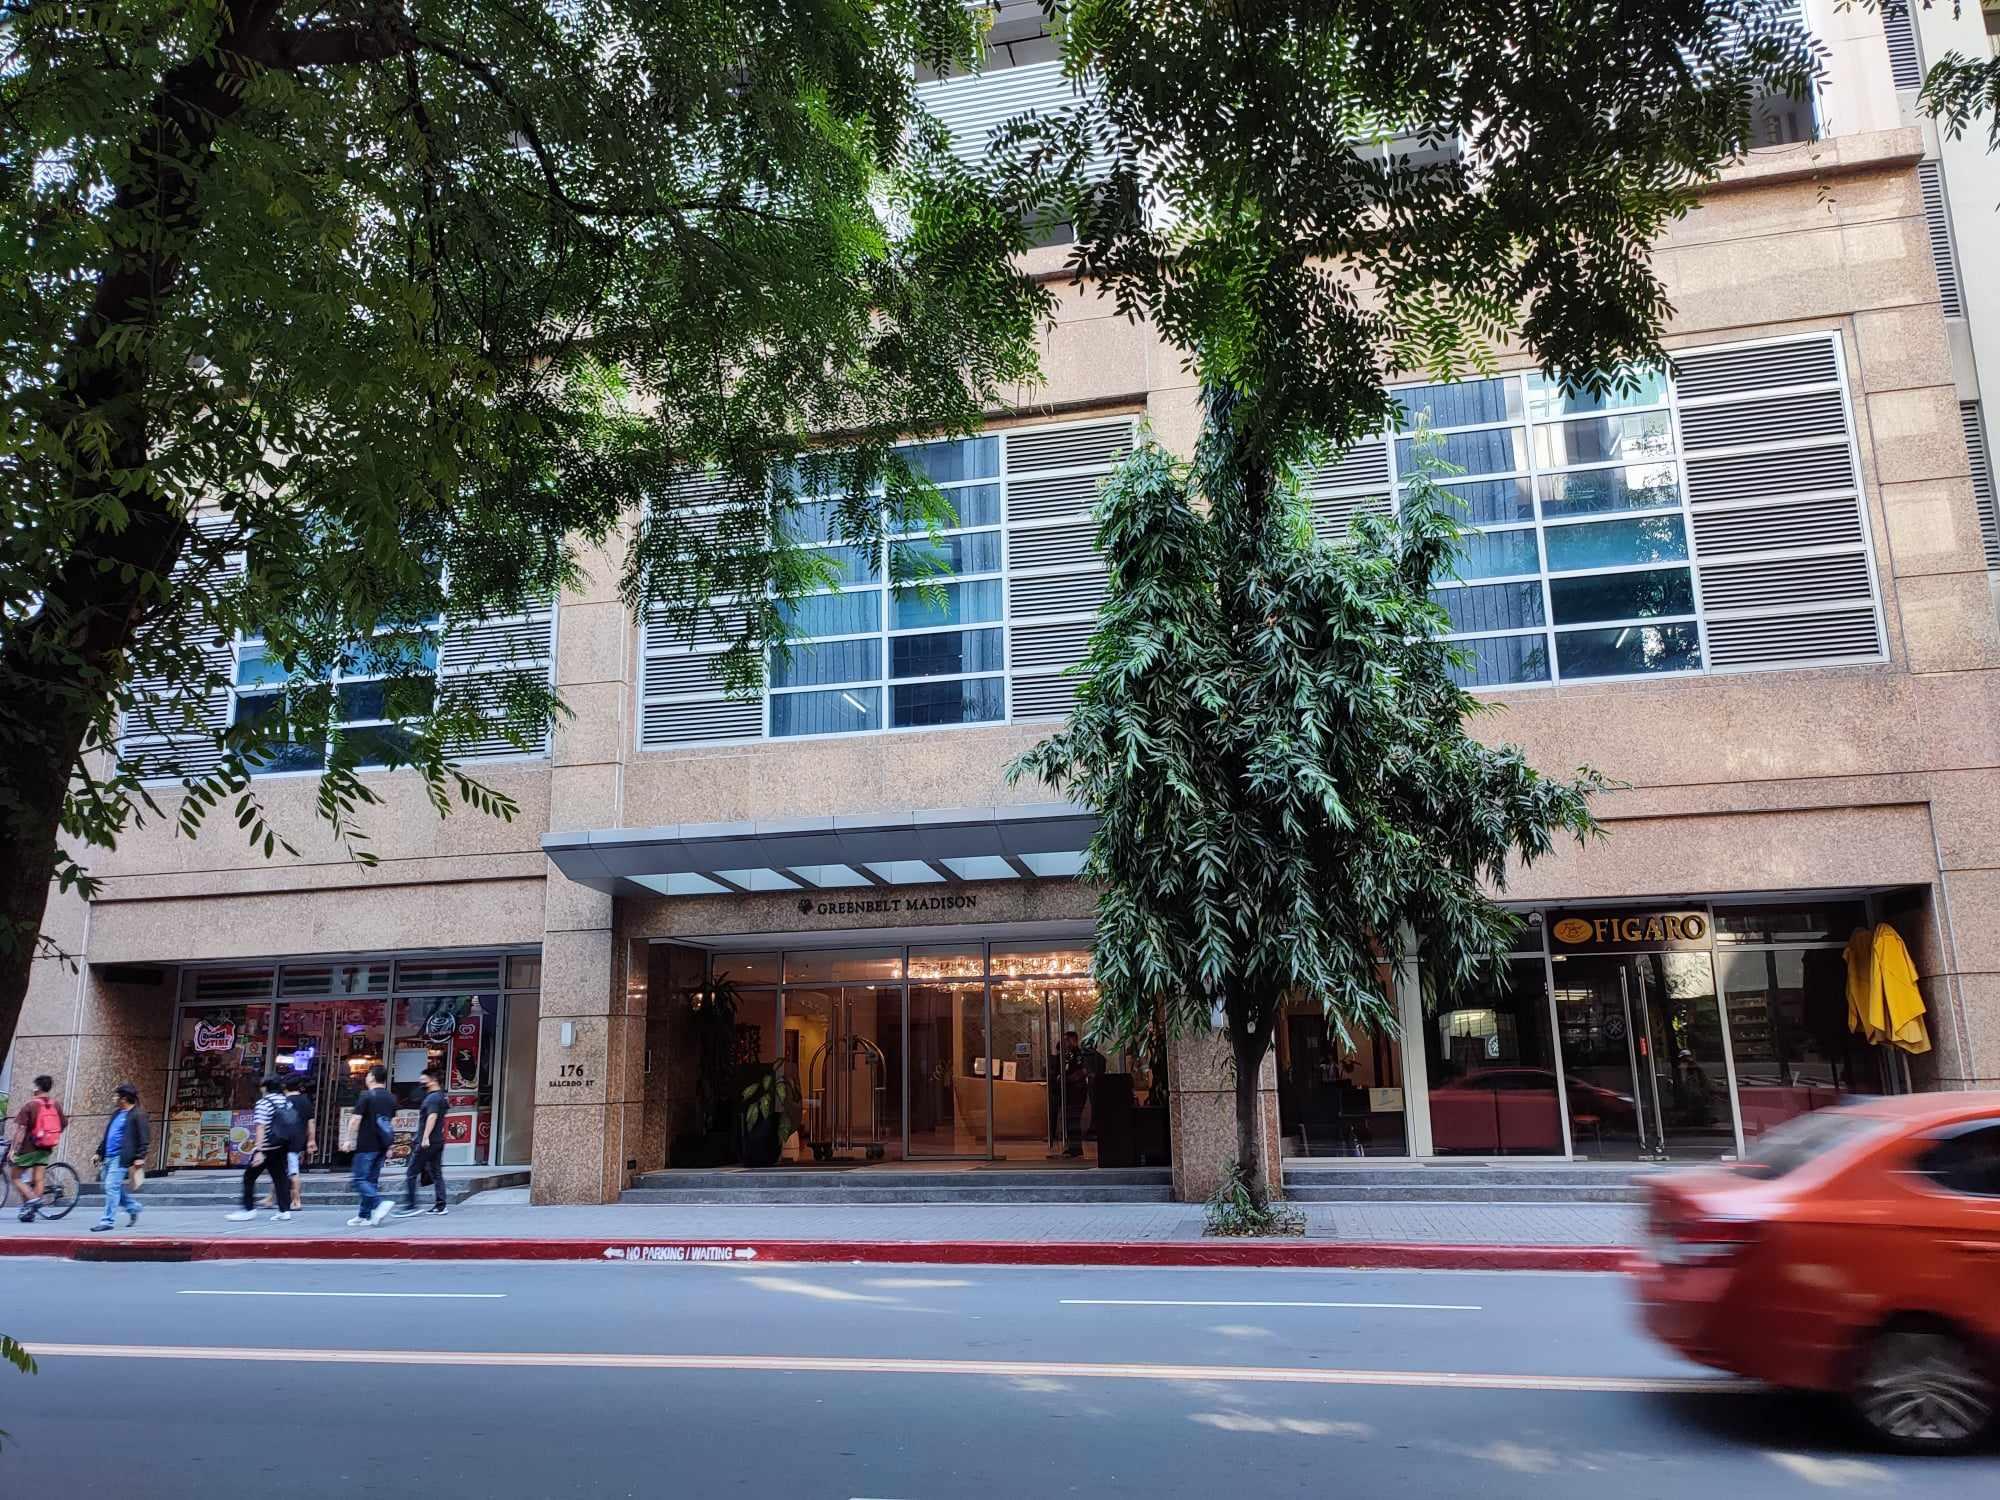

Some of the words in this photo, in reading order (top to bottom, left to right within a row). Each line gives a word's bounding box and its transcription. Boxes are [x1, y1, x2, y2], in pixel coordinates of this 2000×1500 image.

[817, 899, 900, 915] GREENBELT
[905, 895, 977, 911] MADISON
[1593, 914, 1706, 943] FIGARO
[560, 1064, 584, 1077] 176
[626, 1247, 641, 1261] NO
[642, 1246, 684, 1260] PARKING
[691, 1246, 733, 1260] WAITING
